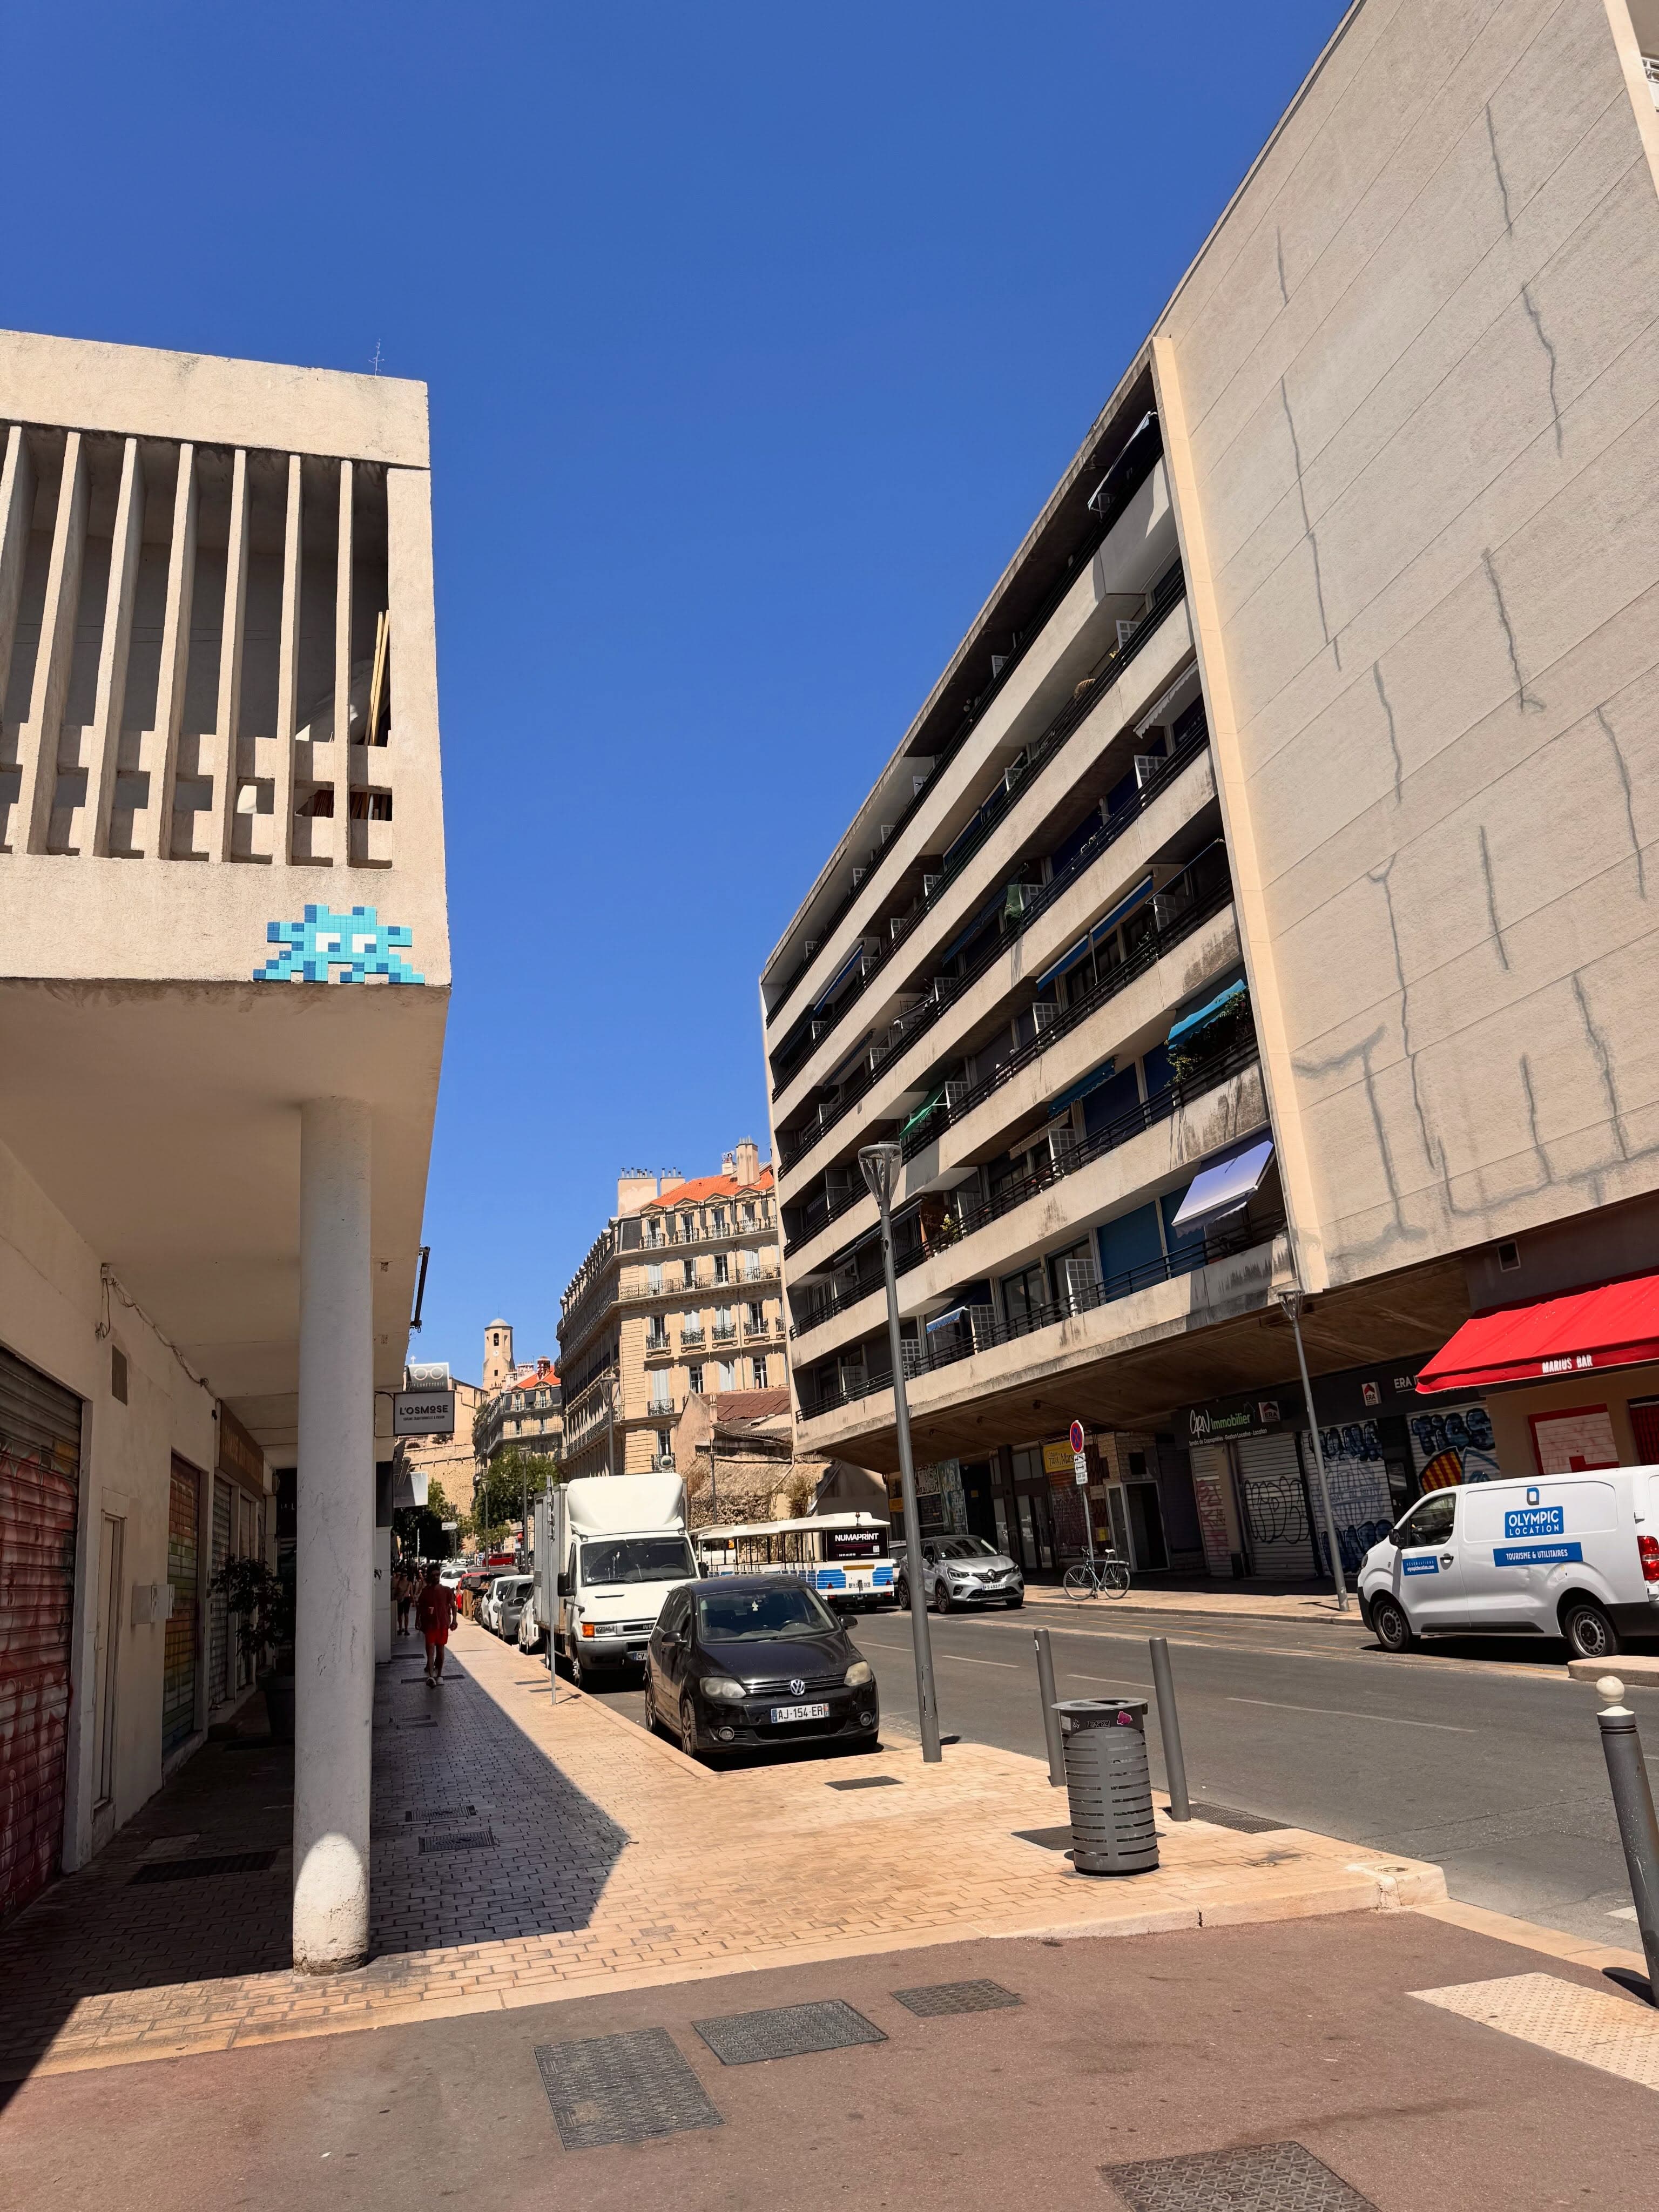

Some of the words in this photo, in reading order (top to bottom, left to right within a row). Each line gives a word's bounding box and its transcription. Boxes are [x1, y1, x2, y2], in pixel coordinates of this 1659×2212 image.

[1542, 1357, 1572, 1373] MARIUS
[1576, 1354, 1593, 1368] BAR
[1394, 1375, 1412, 1388] ERA
[400, 1405, 449, 1415] L'OSMOSE
[1210, 1413, 1251, 1430] Immobilier
[1508, 1509, 1560, 1528] OLYMPIC
[1509, 1524, 1560, 1536] LOCATION
[1506, 1550, 1530, 1560] TOURISME
[1537, 1549, 1568, 1559] UTILITAIRES
[778, 1706, 823, 1719] AJ-154-ER
